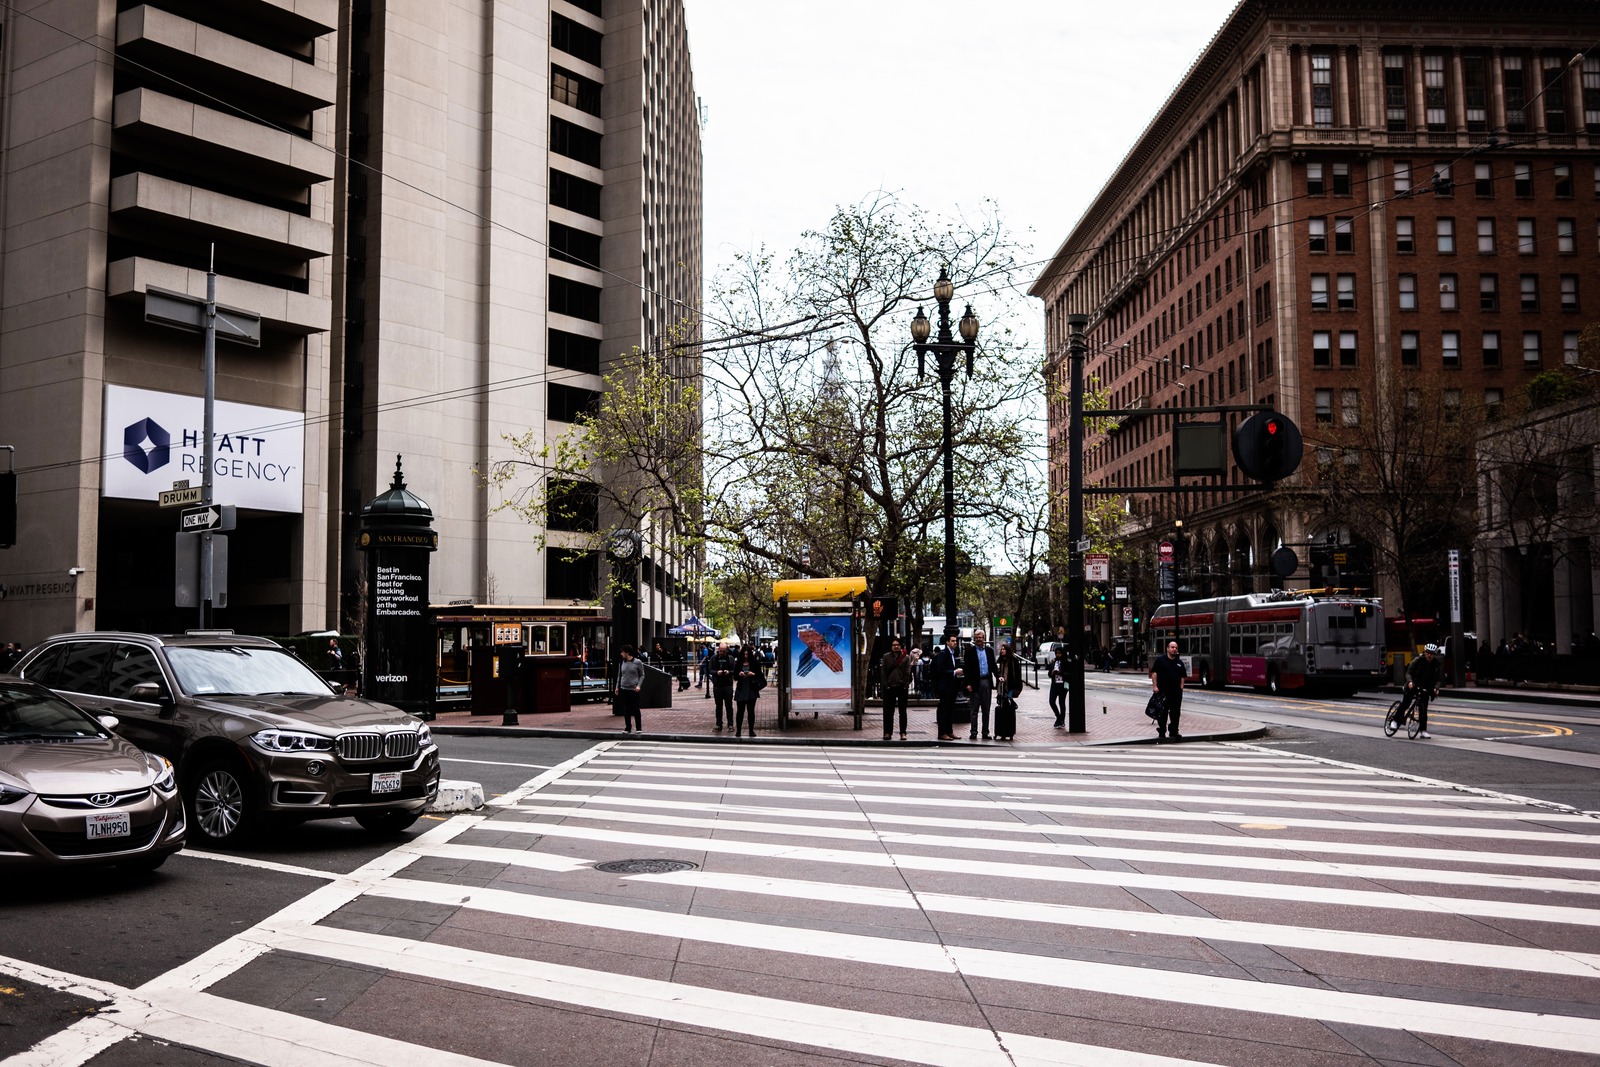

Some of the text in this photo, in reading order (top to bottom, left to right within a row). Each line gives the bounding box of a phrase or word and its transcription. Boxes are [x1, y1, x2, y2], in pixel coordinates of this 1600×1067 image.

[182, 429, 266, 456] HATT
[164, 491, 196, 504] DRUMM
[184, 514, 209, 526] ONE WAY
[10, 582, 75, 596] HYATT REGENCY
[376, 674, 408, 682] verizon
[90, 822, 128, 836] 7LNH950
